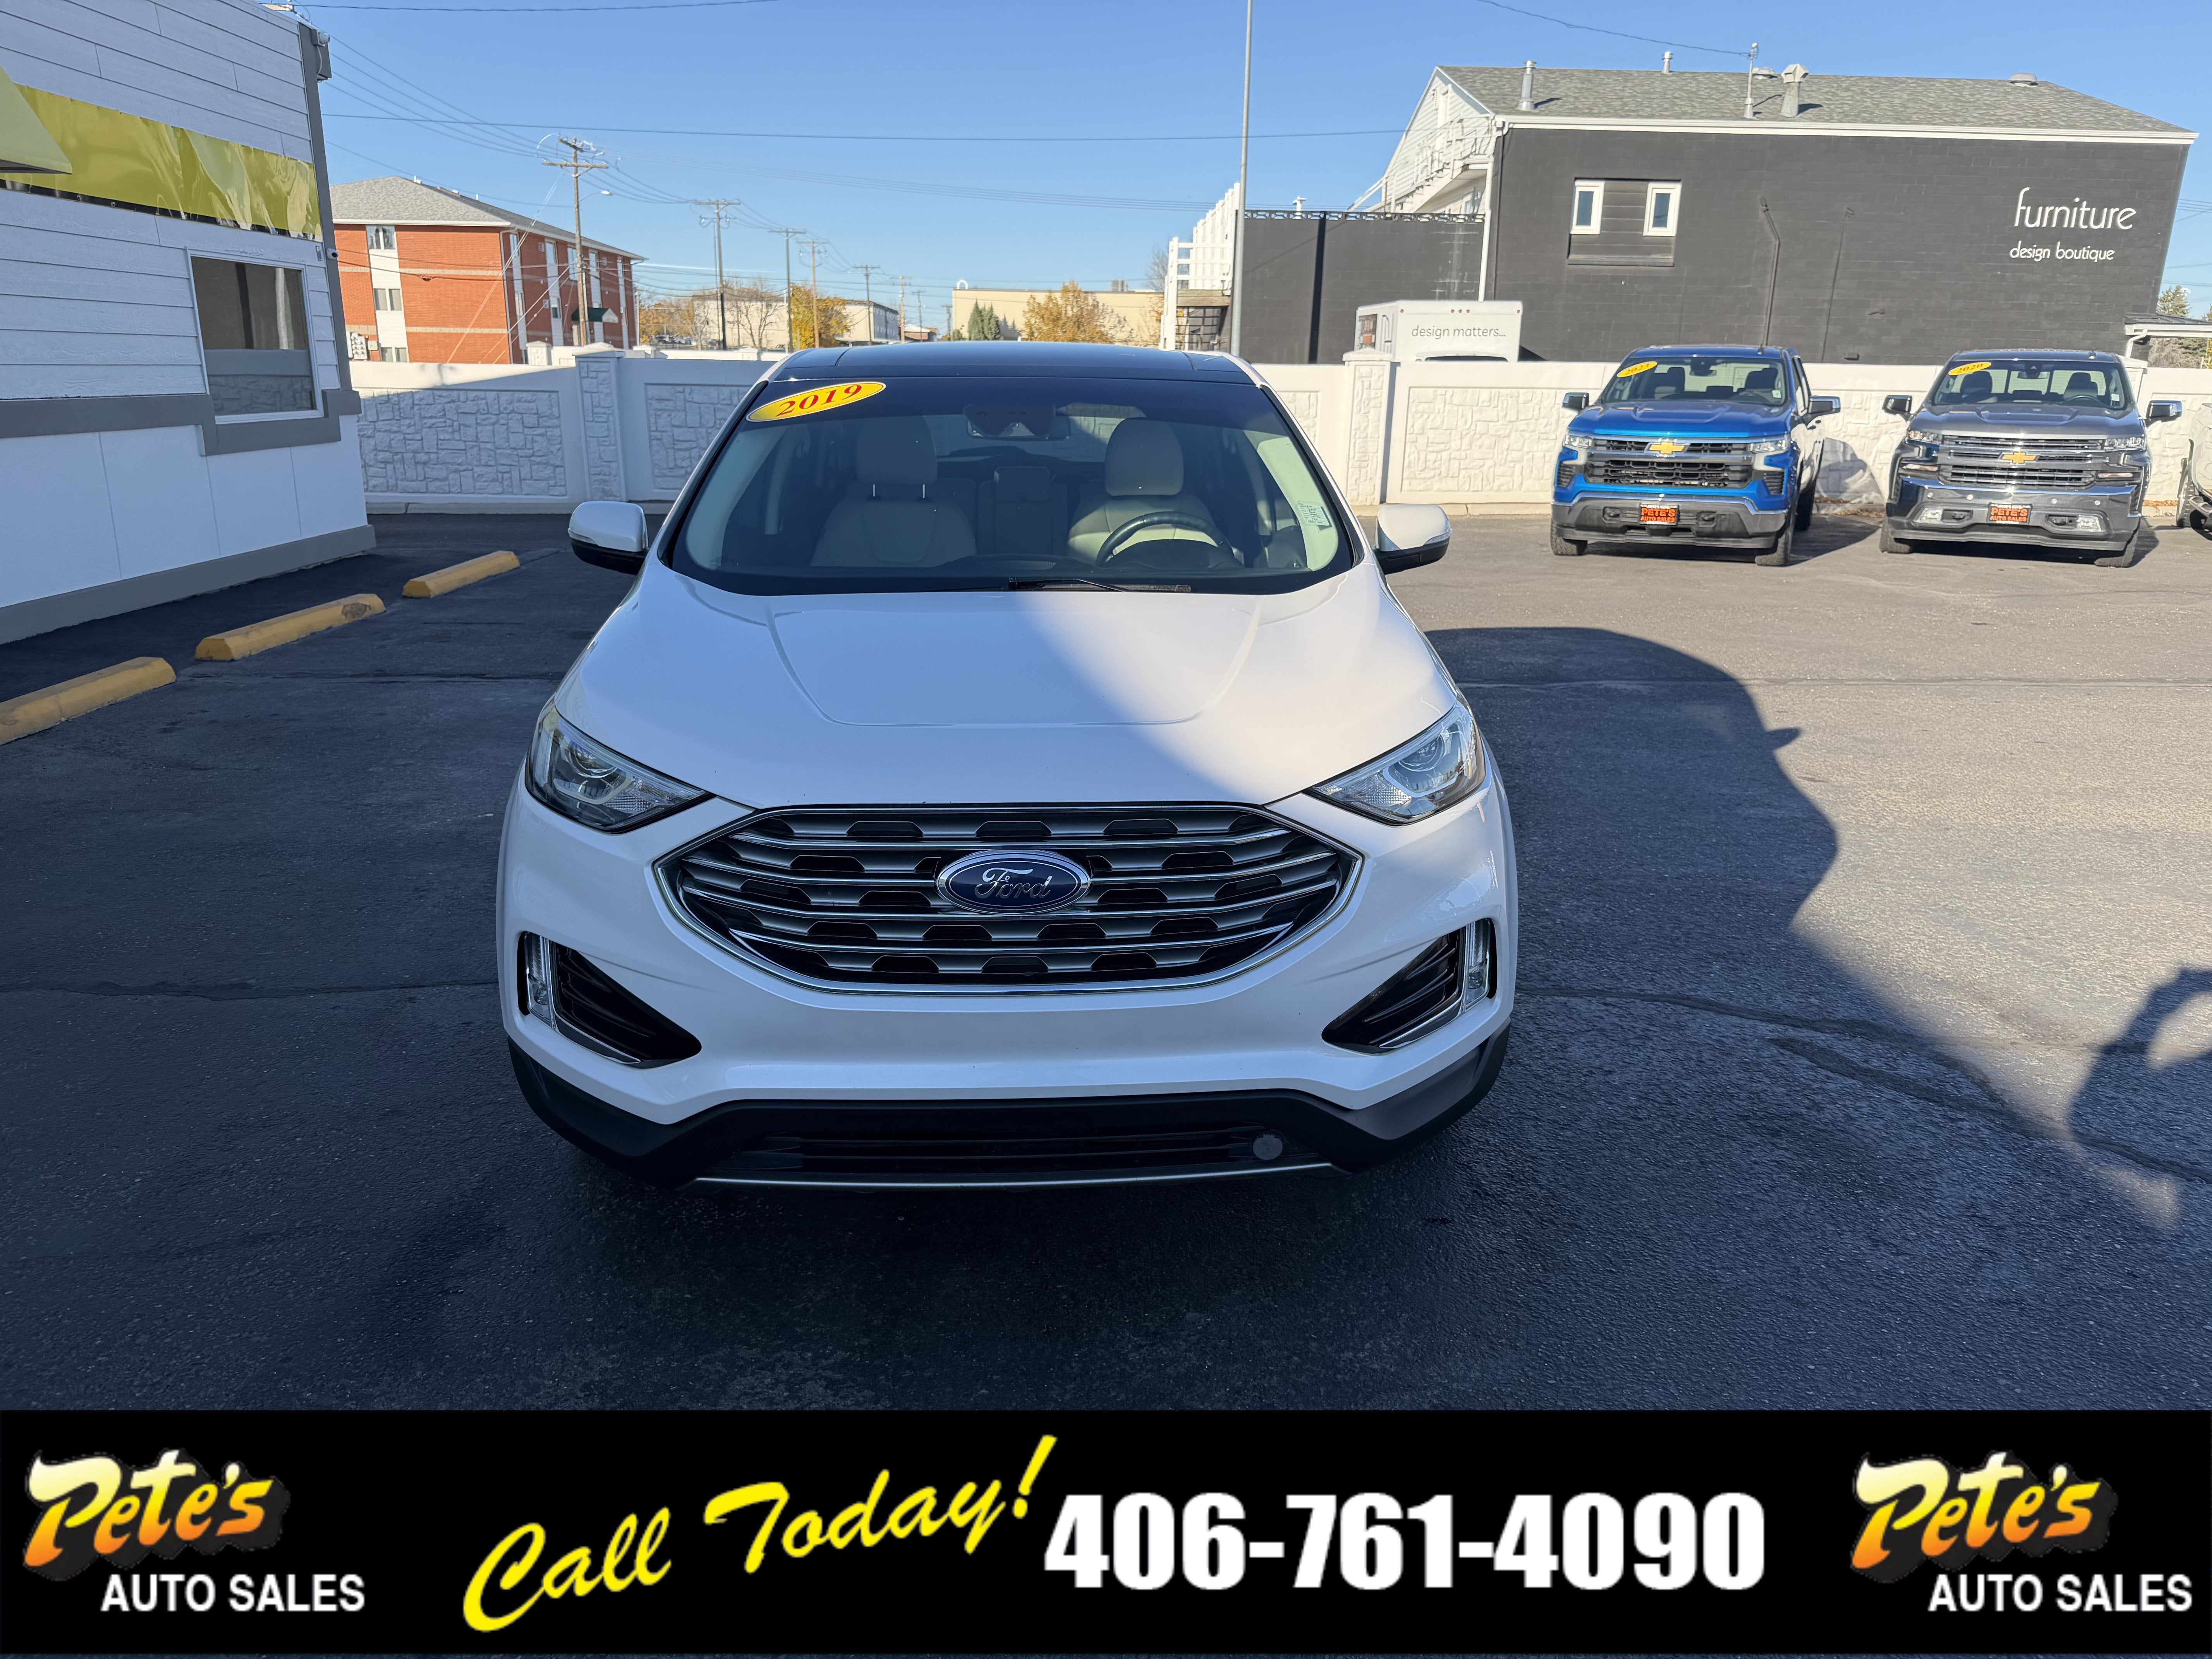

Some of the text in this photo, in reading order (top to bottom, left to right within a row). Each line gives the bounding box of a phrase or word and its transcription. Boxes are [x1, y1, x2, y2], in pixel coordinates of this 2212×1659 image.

[2014, 187, 2136, 230] furniture
[2009, 240, 2115, 263] design boutique
[1412, 325, 1506, 340] design matters...
[1956, 363, 1983, 373] 2020
[776, 385, 862, 417] 2019
[1642, 508, 1676, 517] PETE'S
[1991, 507, 2028, 517] PETE'S
[974, 867, 1053, 899] Ford
